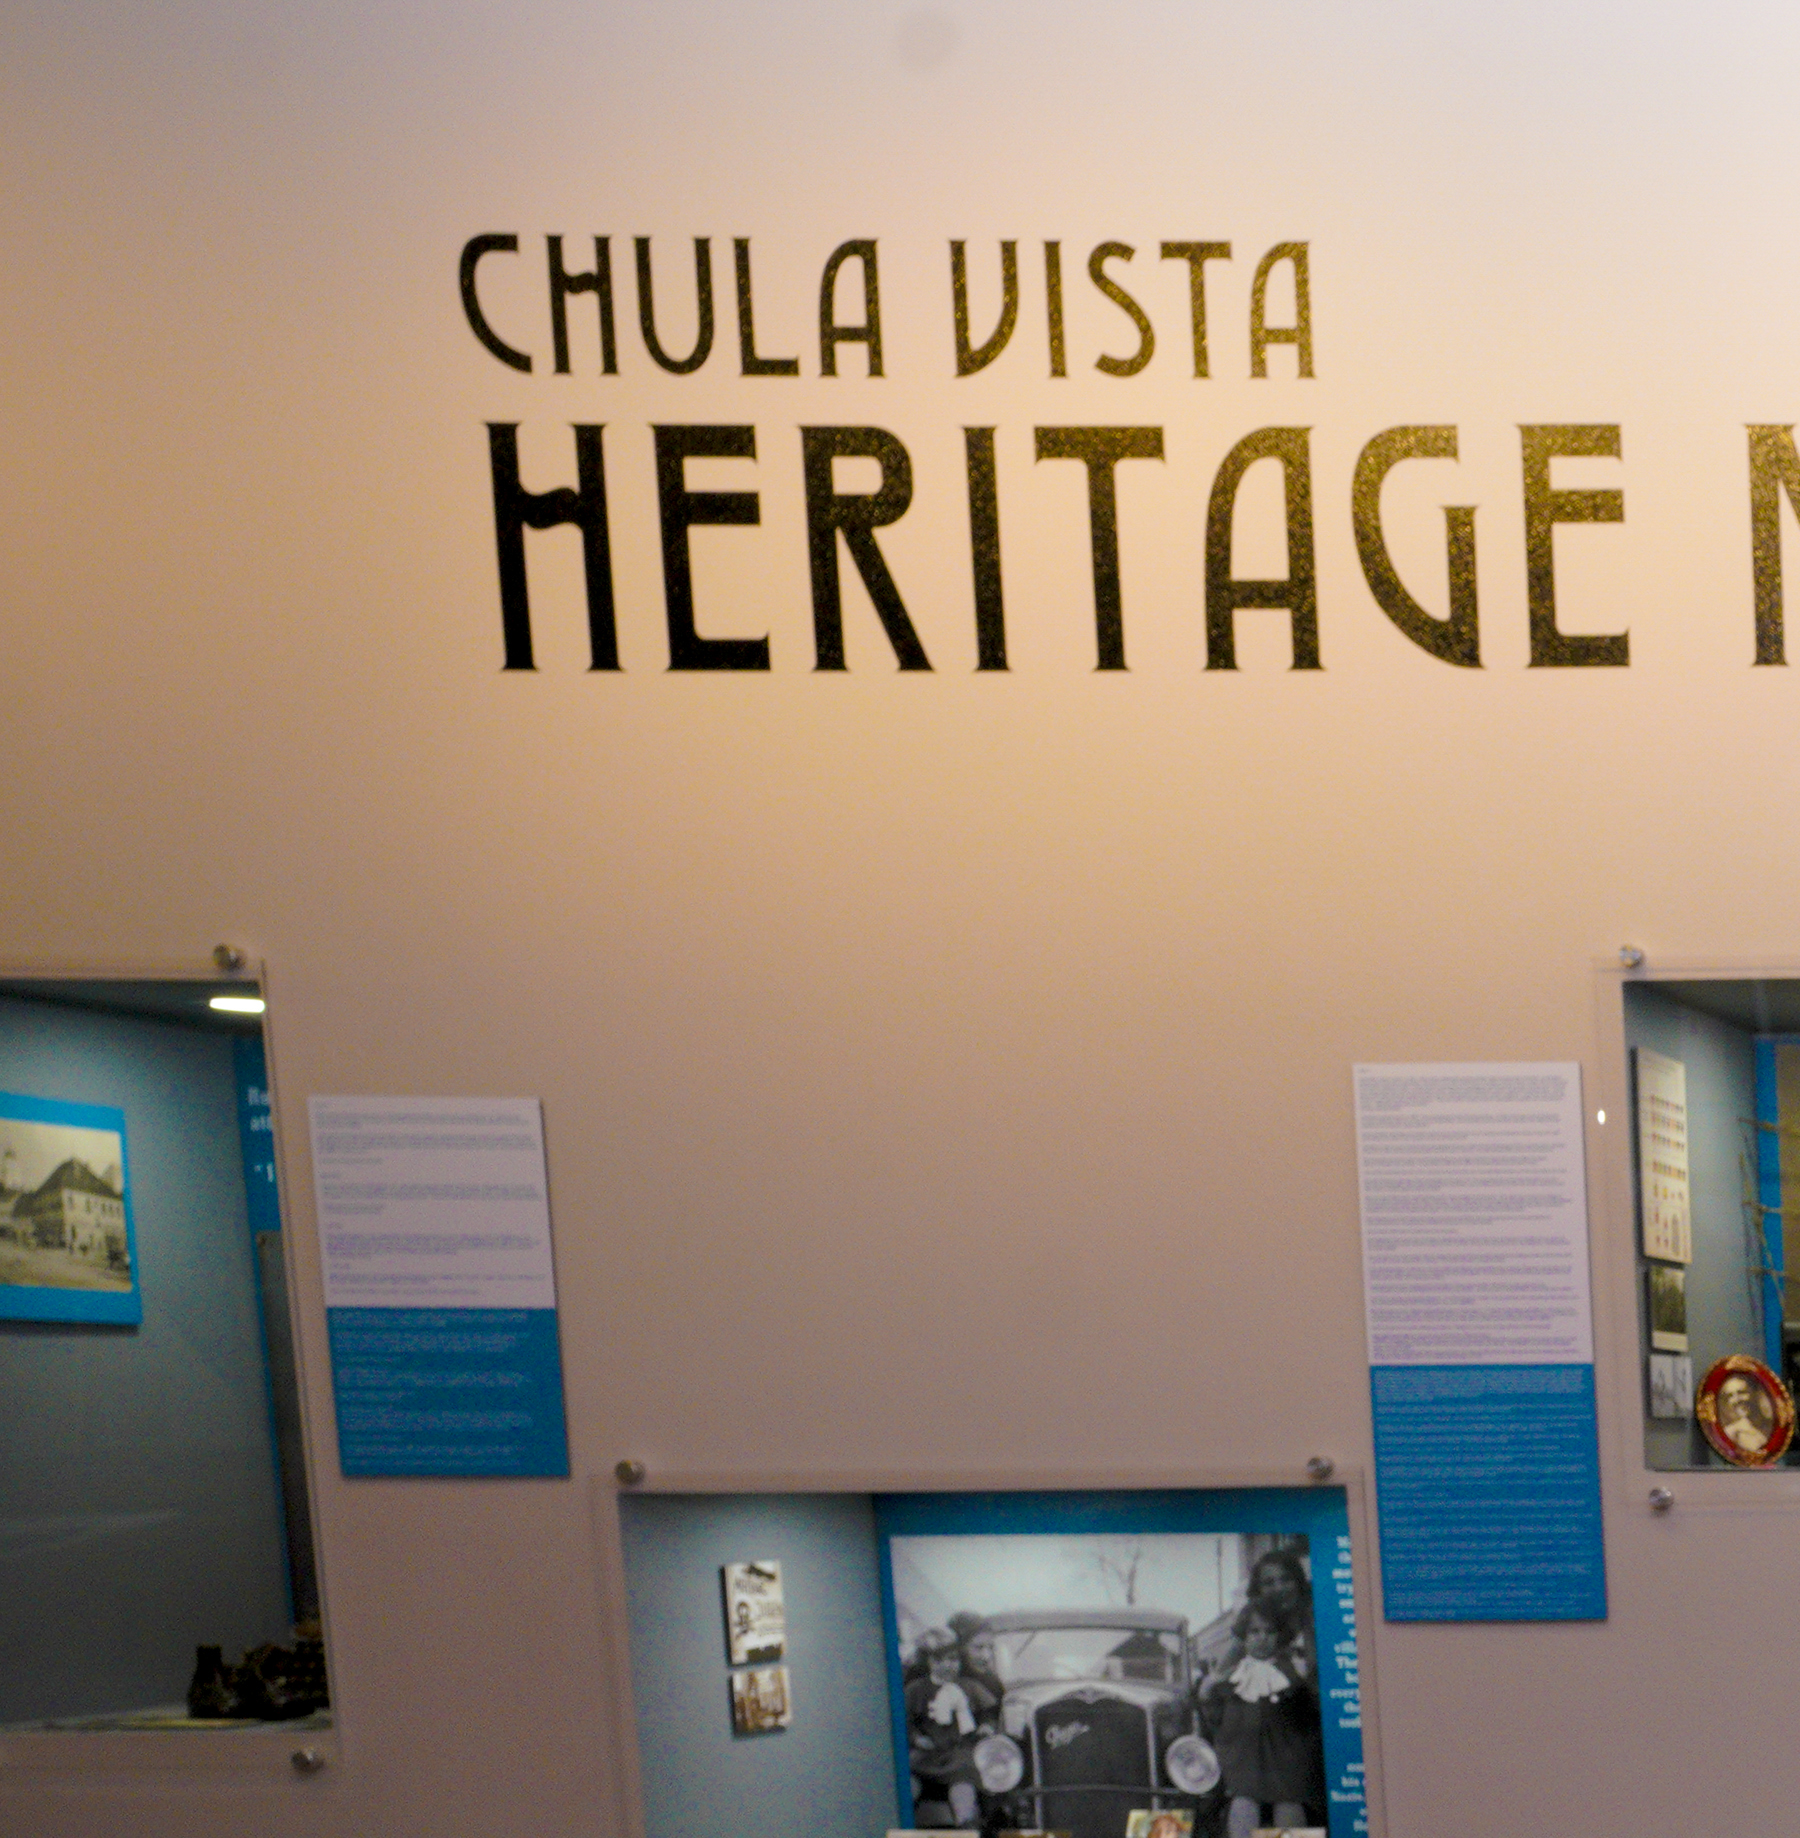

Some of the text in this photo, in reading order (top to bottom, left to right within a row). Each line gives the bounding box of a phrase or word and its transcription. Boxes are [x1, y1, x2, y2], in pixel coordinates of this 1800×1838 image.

[457, 231, 1316, 380] CHULA VISTA
[483, 420, 1632, 674] HERITAGE
